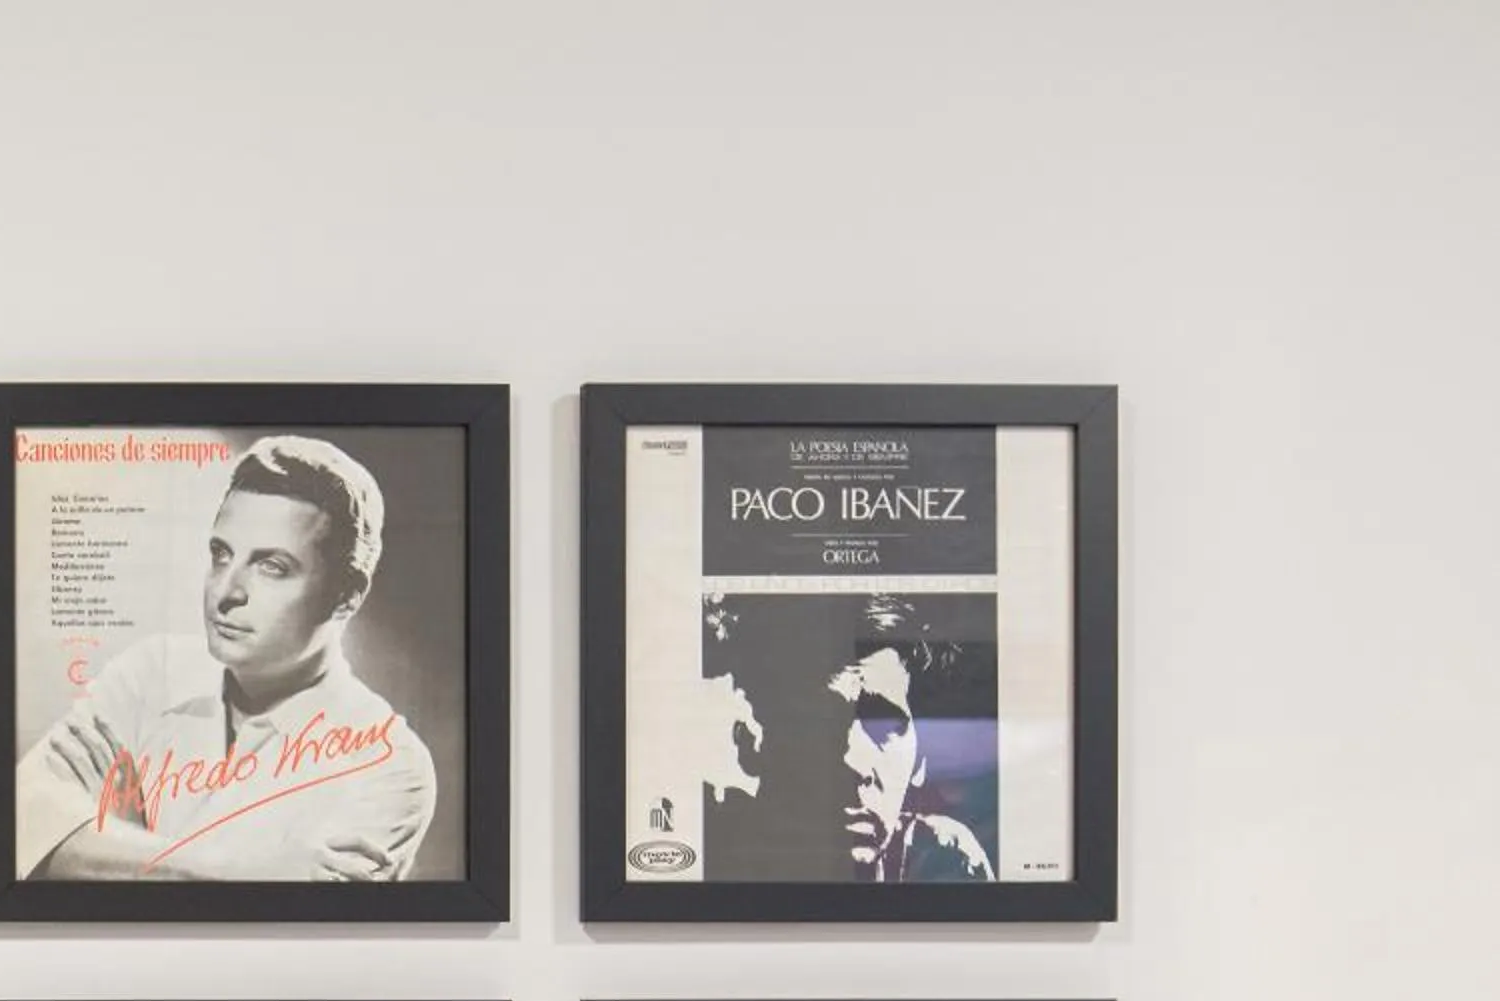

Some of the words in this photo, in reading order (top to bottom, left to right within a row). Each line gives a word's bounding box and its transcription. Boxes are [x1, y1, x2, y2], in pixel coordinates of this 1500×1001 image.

[14, 434, 115, 463] Canciones
[122, 434, 145, 462] de
[151, 437, 230, 468] siempre
[731, 486, 825, 521] PACO
[823, 549, 880, 565] ORTEGA
[97, 740, 257, 833] Alfredo
